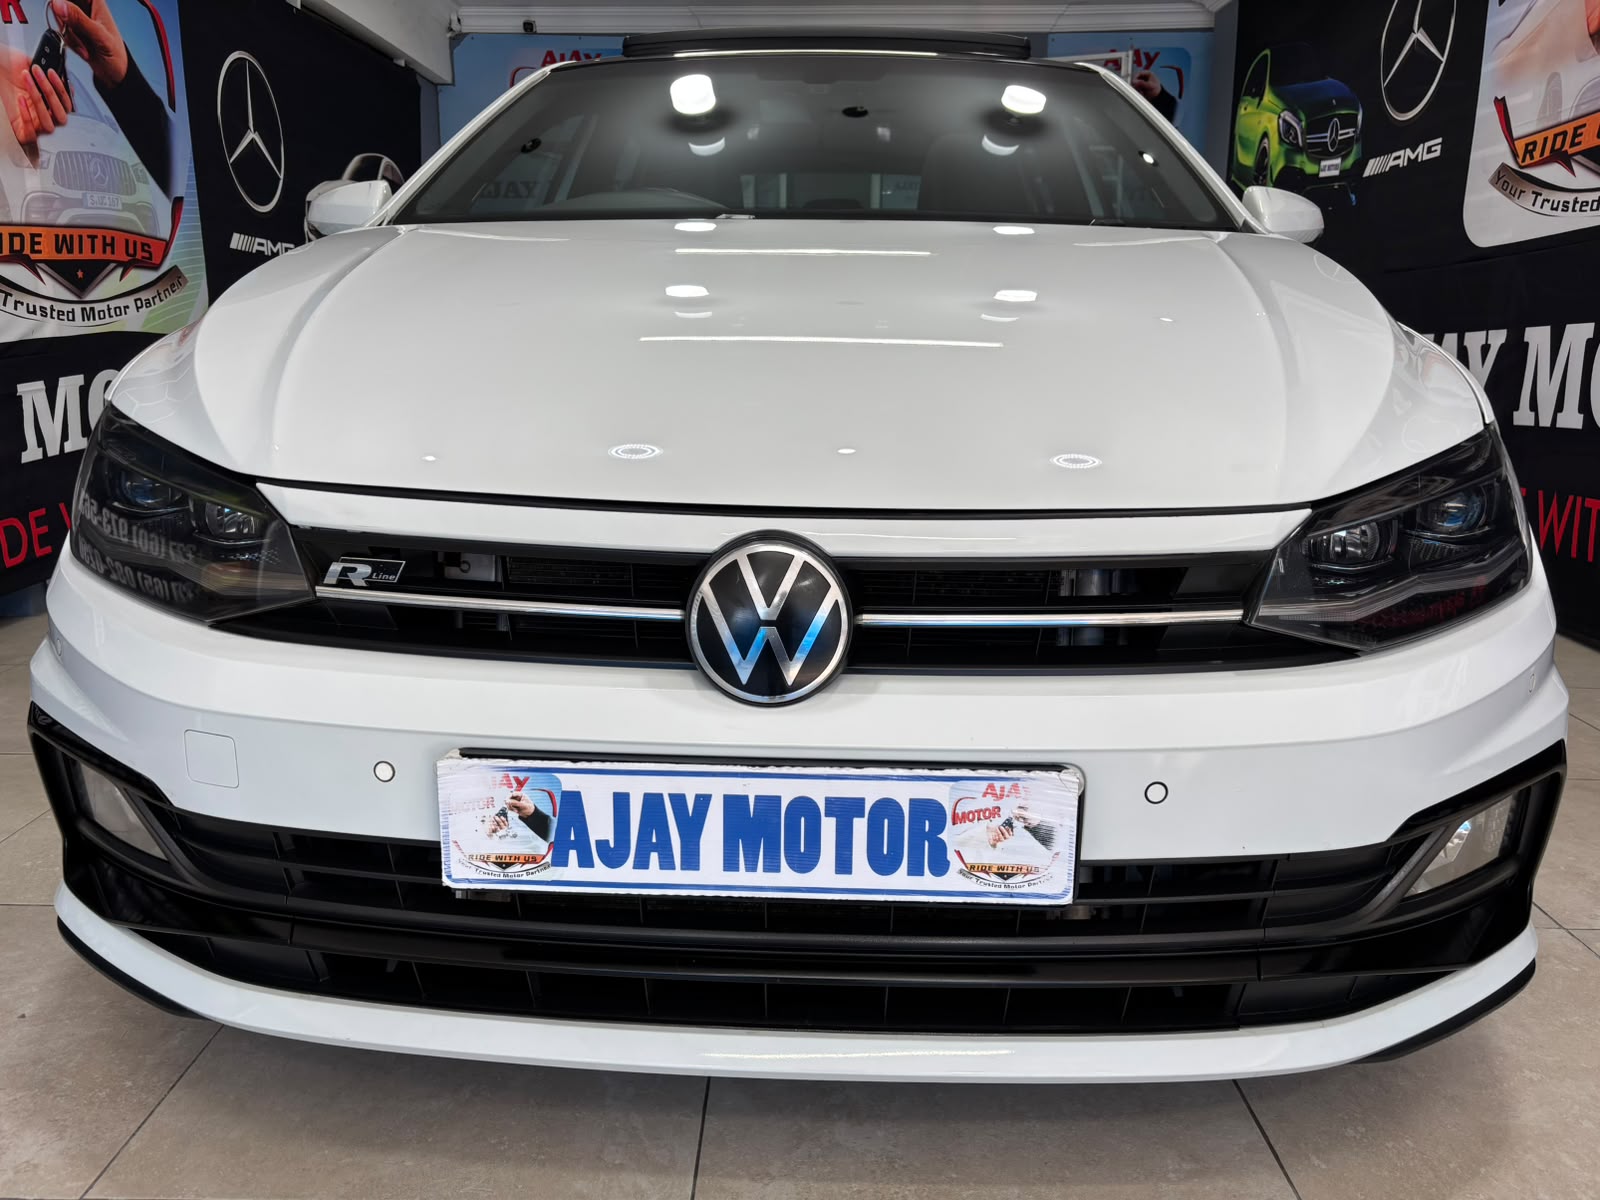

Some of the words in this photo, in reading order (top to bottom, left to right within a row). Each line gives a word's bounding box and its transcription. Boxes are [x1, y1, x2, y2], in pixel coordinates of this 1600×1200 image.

[1387, 137, 1442, 171] AMG
[1521, 123, 1587, 163] RIDE
[1495, 170, 1526, 201] Your
[1531, 190, 1600, 213] Trusted
[55, 233, 115, 255] WITH
[125, 238, 153, 261] US
[0, 290, 76, 322] Trusted
[81, 303, 130, 322] Motor
[134, 275, 182, 312] Partner
[1513, 322, 1600, 430] M
[323, 562, 368, 587] R
[372, 572, 395, 581] Line
[982, 783, 1029, 801] AJA
[955, 806, 1001, 825] MOTOR
[551, 790, 712, 870] AJAY
[723, 794, 951, 877] MOTOR
[495, 854, 520, 862] WITH
[969, 864, 993, 872] RIDE
[997, 865, 1023, 873] WITH
